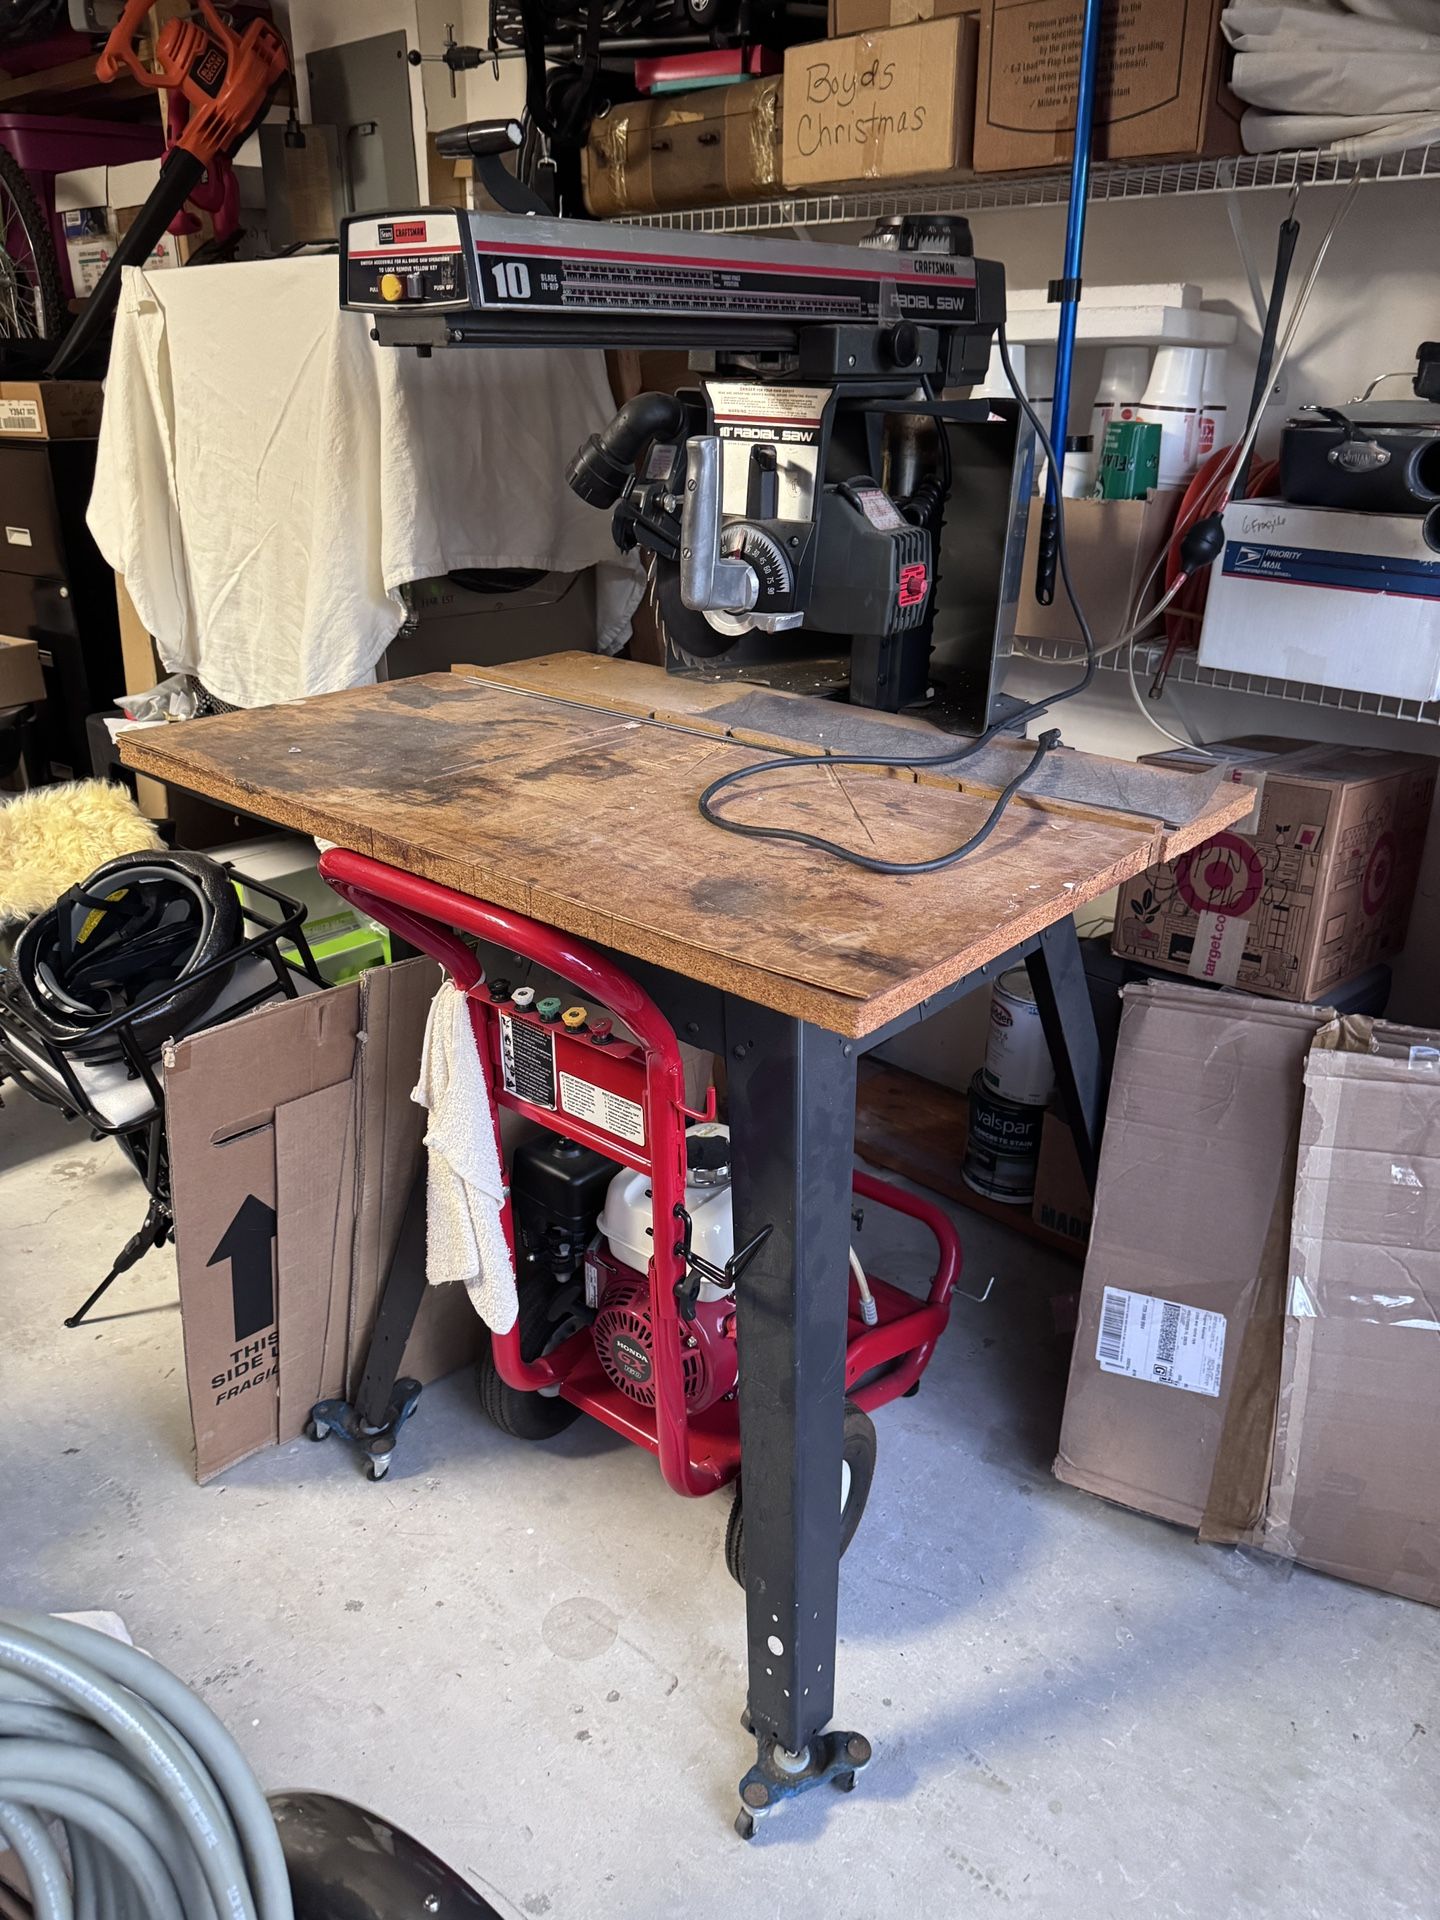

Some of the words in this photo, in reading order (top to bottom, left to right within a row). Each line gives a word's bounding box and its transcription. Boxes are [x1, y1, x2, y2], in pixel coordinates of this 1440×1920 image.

[806, 58, 896, 107] Boyds
[797, 101, 926, 156] Christmas
[395, 226, 425, 238] CRAFTSMAN
[492, 262, 532, 298] 10
[541, 273, 558, 282] BLADE
[914, 260, 957, 276] CRAFTSMAN
[760, 556, 766, 565] 45
[1262, 560, 1282, 570] MAIL
[1266, 549, 1302, 560] PRIORITY
[976, 1106, 1036, 1136] valspar
[230, 1330, 279, 1364] THIS
[616, 1340, 648, 1364] HONDA
[211, 1352, 264, 1390] SIDE
[618, 1350, 646, 1374] GX
[216, 1364, 279, 1406] FRAGIL
